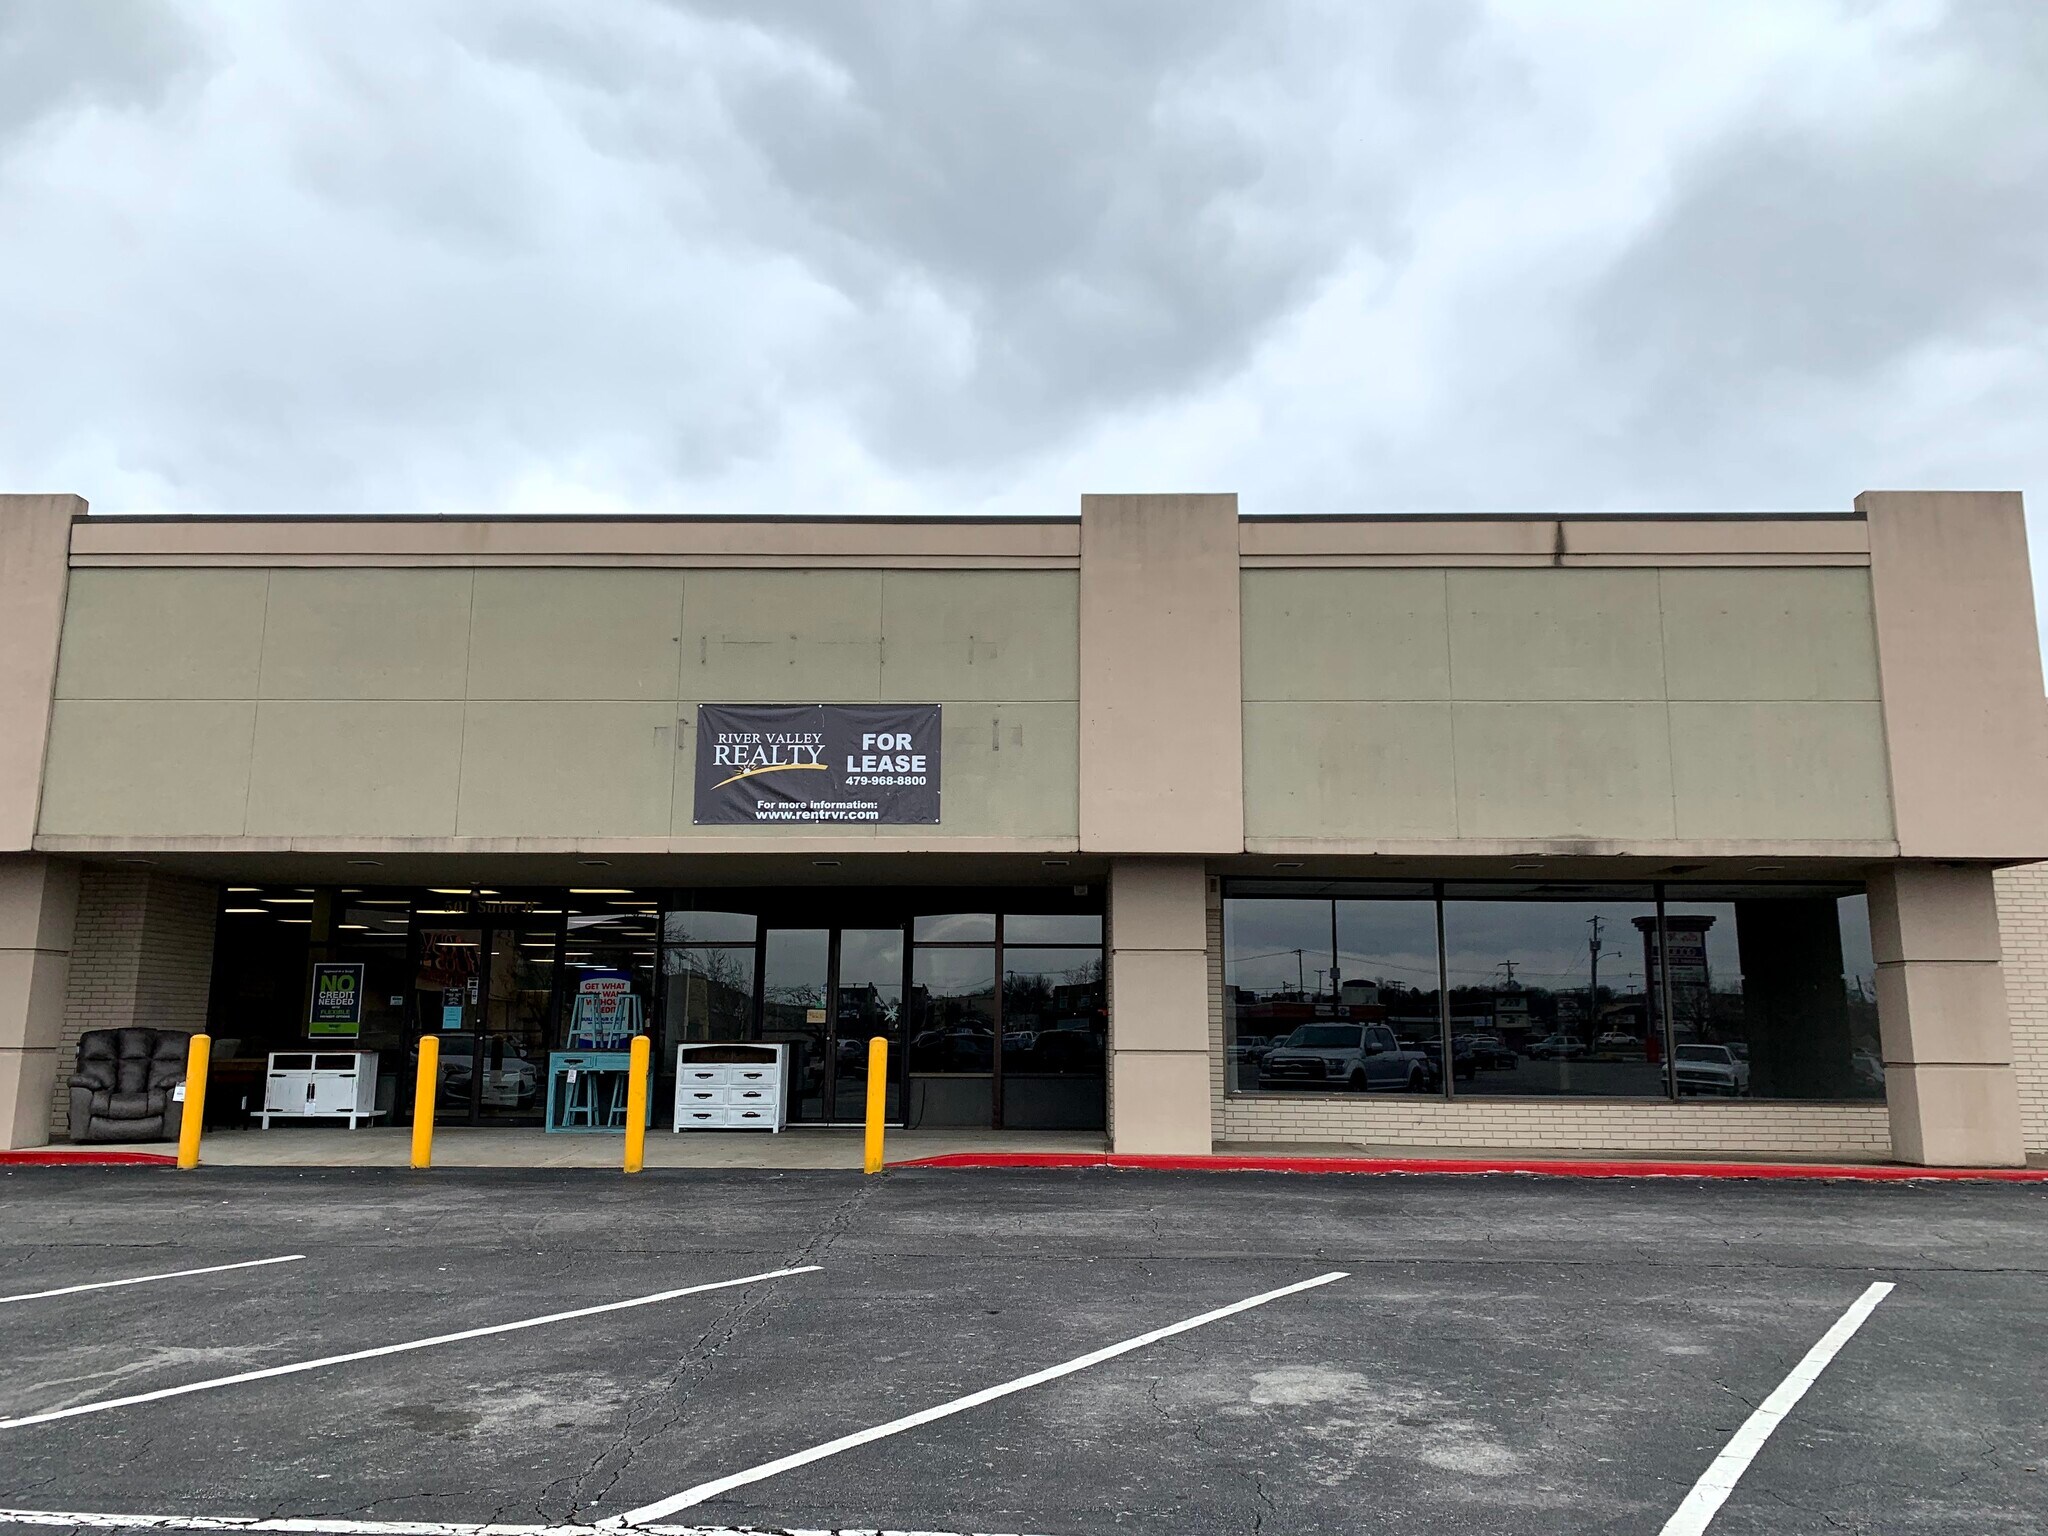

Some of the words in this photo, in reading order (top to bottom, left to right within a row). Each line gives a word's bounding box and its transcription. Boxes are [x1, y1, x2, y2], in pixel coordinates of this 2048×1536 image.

[718, 733, 761, 744] RIVER
[766, 733, 822, 744] VALLEY
[862, 733, 913, 751] FOR
[713, 744, 826, 766] REALTY
[847, 755, 926, 773] LEASE
[845, 776, 926, 786] 479-968-8800
[757, 800, 776, 809] For
[810, 800, 878, 809] information:
[755, 809, 879, 820] www.rentrvr.com
[477, 900, 518, 914] Suite
[320, 974, 355, 991] NO
[319, 991, 355, 999] CREDIT
[318, 998, 354, 1006] NEEDED
